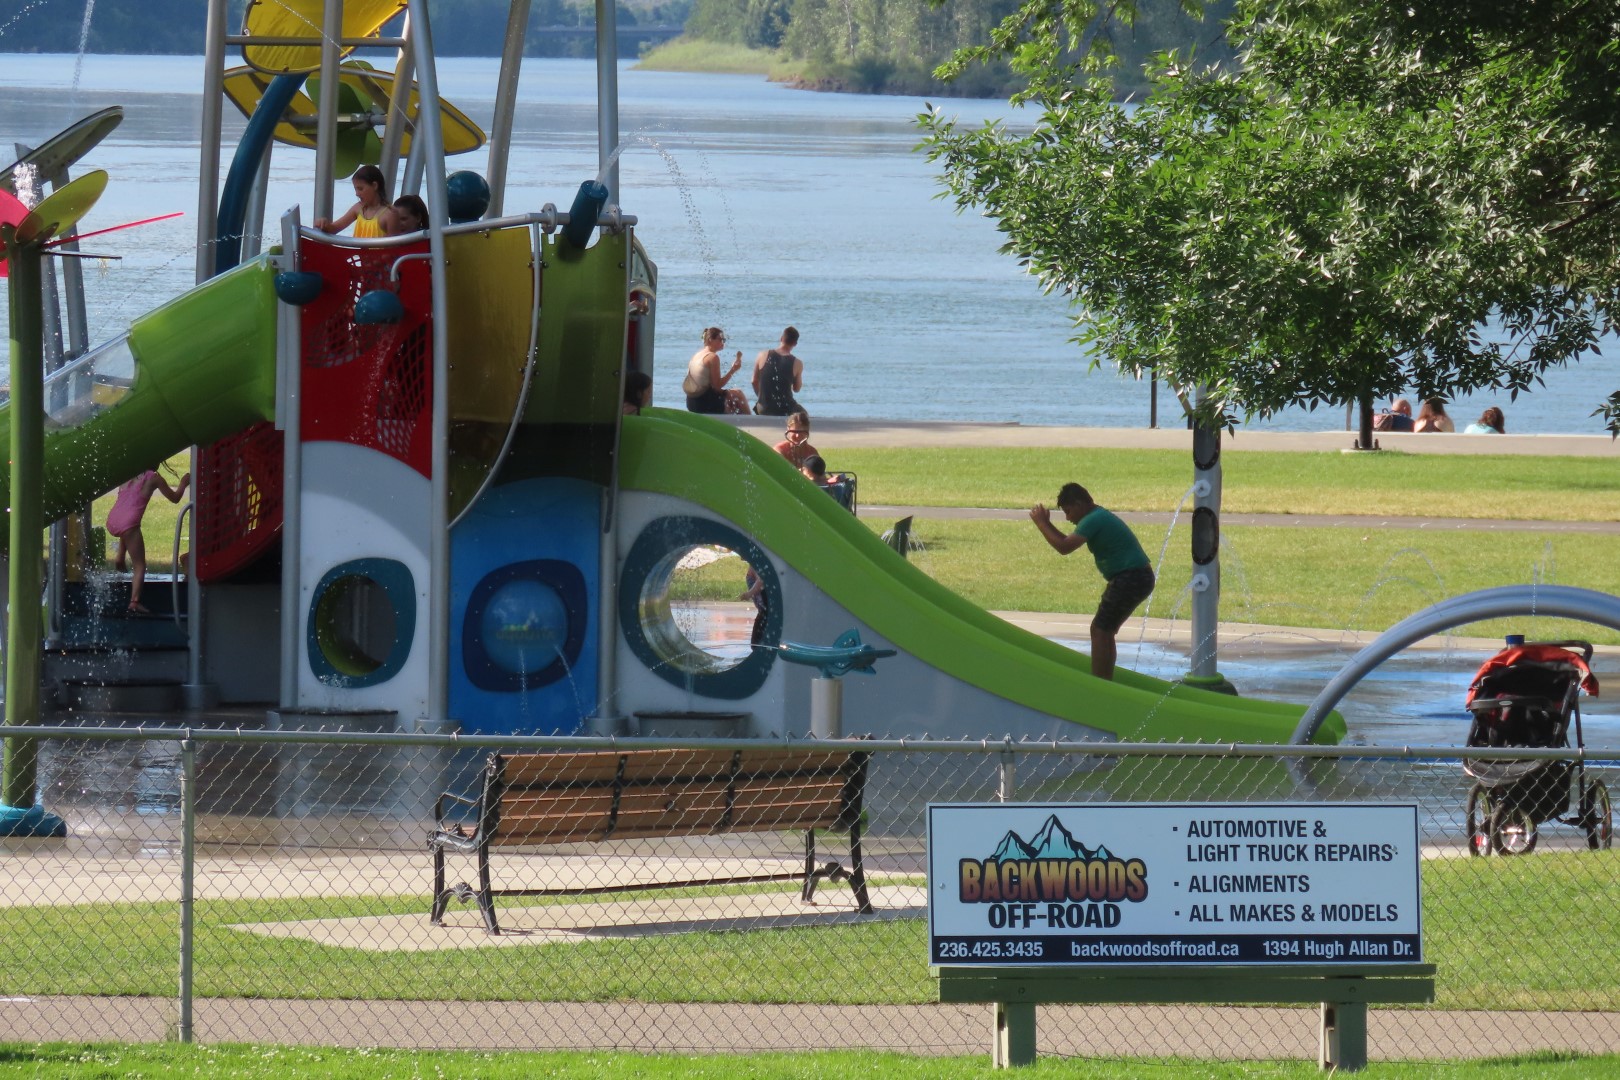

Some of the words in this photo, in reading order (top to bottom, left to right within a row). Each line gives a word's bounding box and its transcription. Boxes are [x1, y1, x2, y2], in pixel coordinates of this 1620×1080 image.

[1187, 820, 1307, 838] AUTOMOTIVE
[1313, 821, 1327, 838] &
[1187, 844, 1241, 863] LIGHT
[1247, 844, 1309, 862] TRUCK
[1315, 844, 1393, 862] REPAIRS
[960, 858, 1147, 903] BACKWOODS
[1188, 875, 1310, 893] ALIGNMENTS
[988, 903, 1121, 929] OFF-ROAD
[1189, 905, 1224, 922] ALL
[1230, 904, 1296, 922] MAKES
[1301, 905, 1315, 922] &
[1321, 904, 1398, 922] MODELS
[939, 942, 1043, 957] 236.425.3435
[1072, 941, 1239, 957] backwoodsoffroad.ca
[1263, 941, 1300, 956] 1394
[1304, 941, 1344, 959] Hugh
[1349, 941, 1388, 955] Allan
[1392, 941, 1413, 955] Dr.
